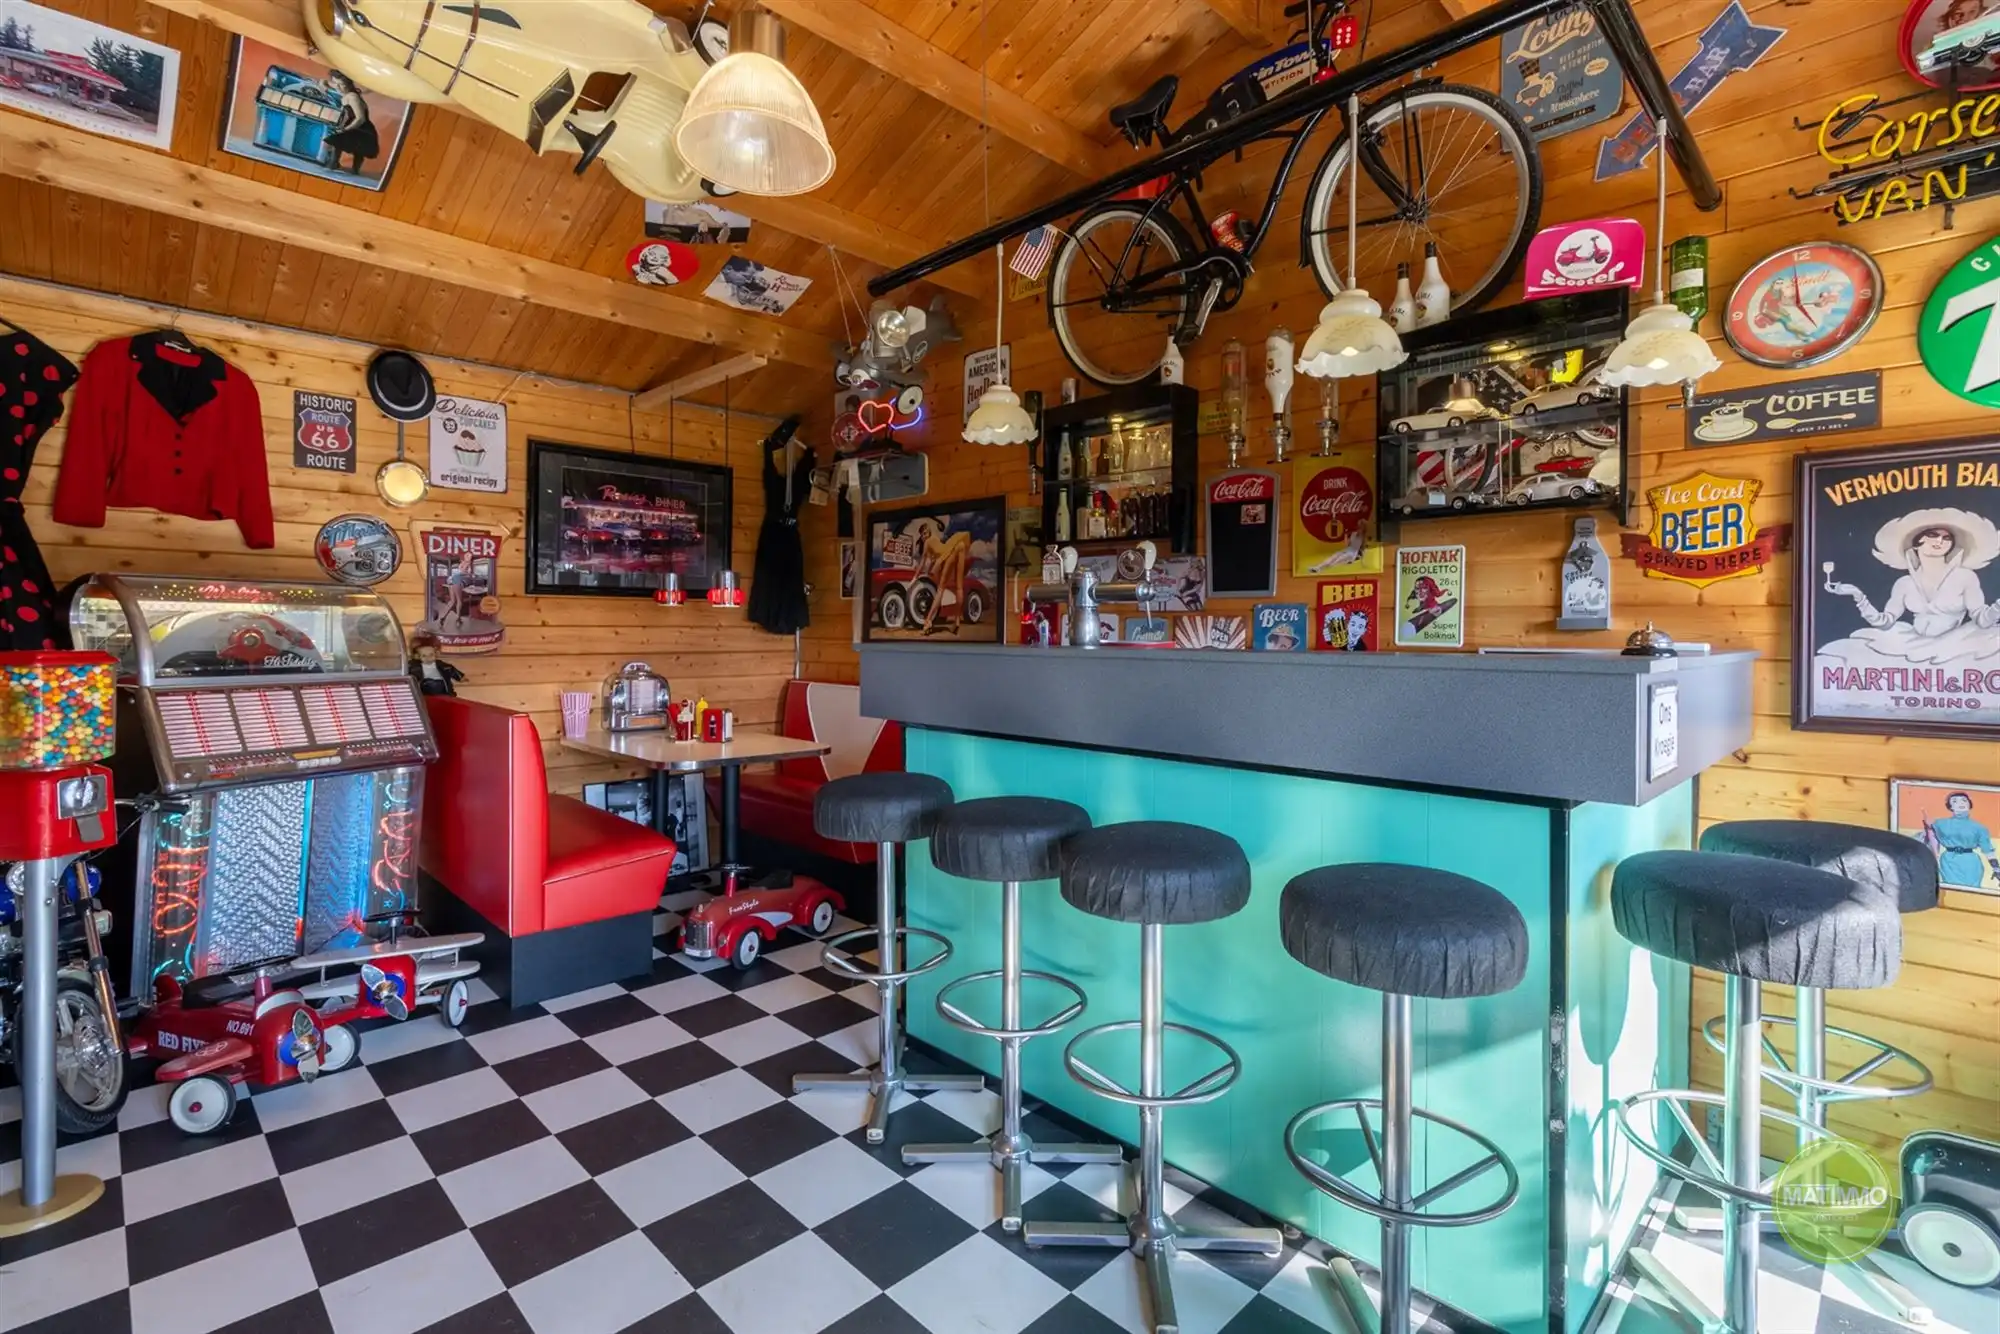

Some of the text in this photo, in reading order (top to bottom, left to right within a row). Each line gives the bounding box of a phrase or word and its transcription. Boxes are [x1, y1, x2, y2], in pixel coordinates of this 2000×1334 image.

[1684, 47, 1730, 93] BAR
[1838, 164, 1968, 223] VAN
[1792, 250, 1811, 262] 12
[1540, 261, 1625, 287] Scooter
[968, 358, 1007, 379] AMERICN
[300, 393, 353, 413] HISTORIC
[436, 398, 500, 421] Delicious
[1766, 385, 1876, 416] COFFEE
[311, 412, 341, 425] ROUTE
[311, 431, 340, 449] 66
[306, 453, 347, 470] ROUTE
[440, 471, 498, 489] original recipy
[1323, 477, 1348, 490] DRINK
[1824, 463, 1949, 507] VERMOUTH
[1662, 485, 1692, 505] Ice
[1661, 502, 1746, 553] BEER
[428, 534, 496, 557] DINER
[1401, 550, 1459, 565] HOFNAR
[1644, 548, 1762, 572] SERVED HERE
[1401, 565, 1458, 575] RIGOLETTO
[1322, 583, 1374, 606] BEER
[1259, 608, 1300, 628] BEER
[1433, 622, 1457, 630] Super
[1423, 631, 1457, 640] Bolknak
[1890, 695, 1982, 710] TORINO
[158, 1030, 179, 1050] RED
